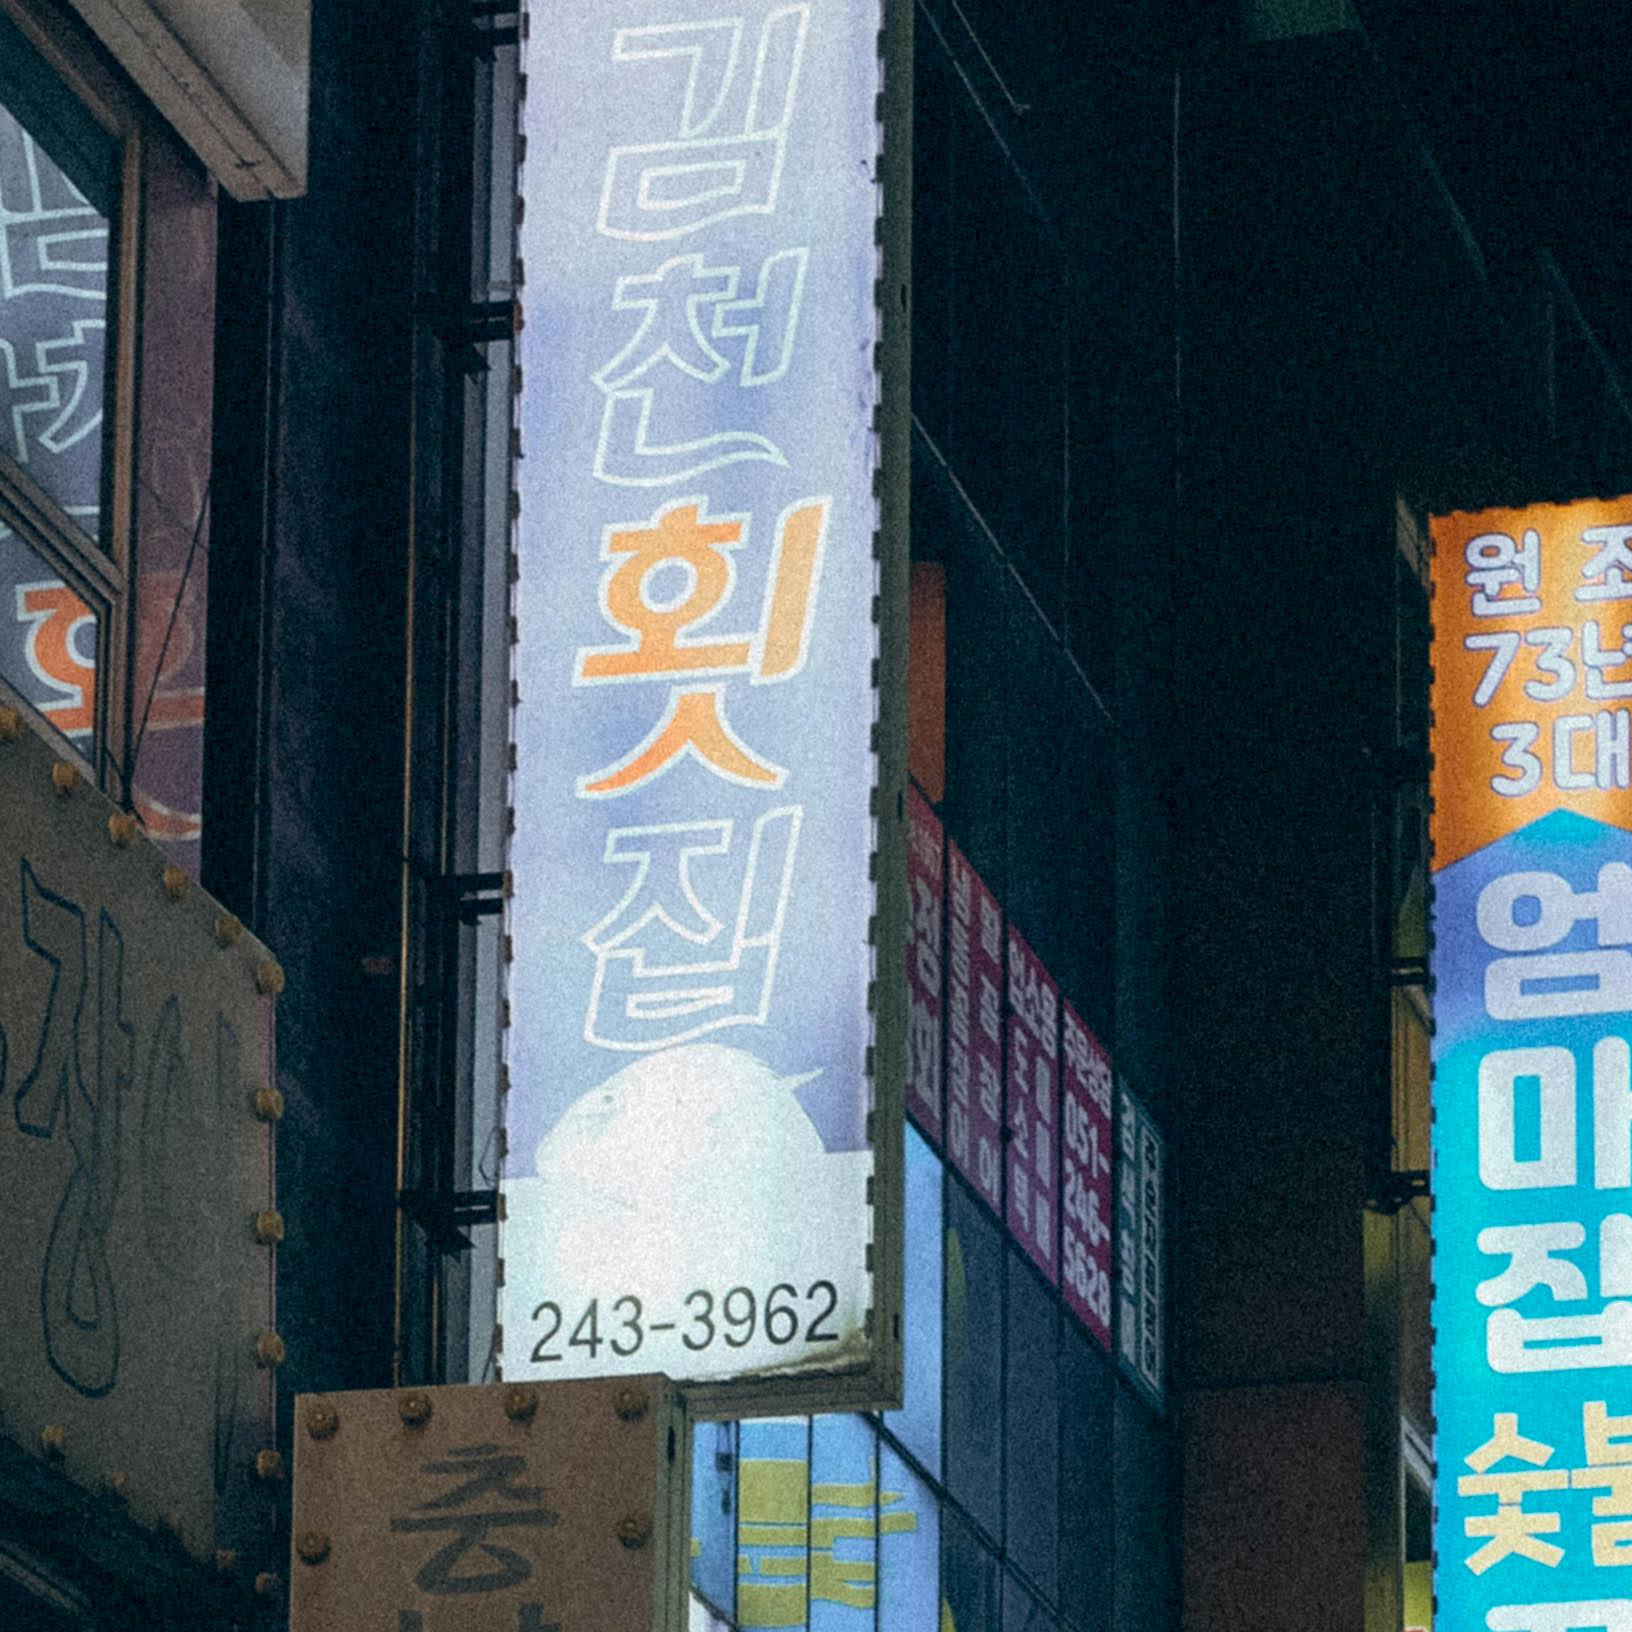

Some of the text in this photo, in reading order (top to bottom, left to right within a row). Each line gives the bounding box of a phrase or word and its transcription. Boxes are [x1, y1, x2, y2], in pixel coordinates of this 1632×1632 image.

[573, 4, 832, 1053] 김천횟집
[1488, 710, 1632, 797] 3대
[529, 1279, 842, 1367] 243-3962
